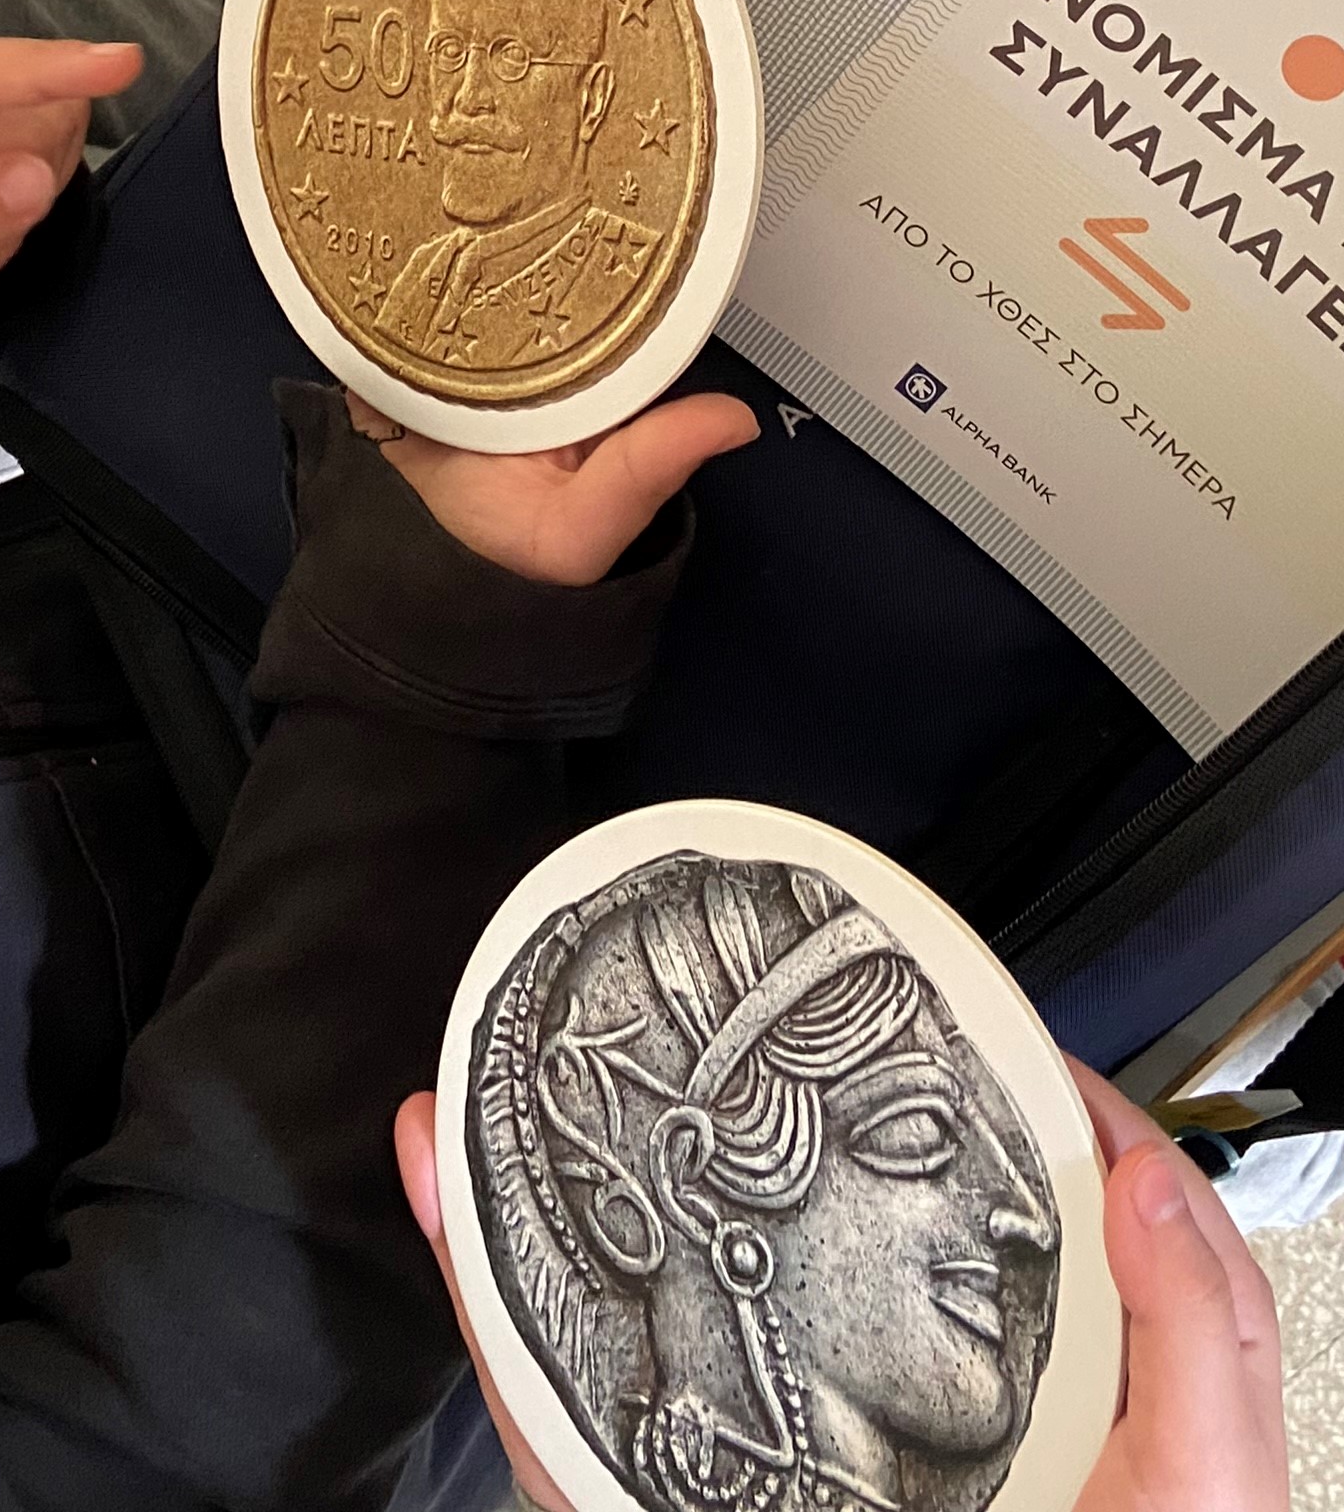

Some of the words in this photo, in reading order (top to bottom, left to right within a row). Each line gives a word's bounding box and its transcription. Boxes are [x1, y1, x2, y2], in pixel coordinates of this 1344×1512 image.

[317, 5, 415, 98] 50
[296, 107, 426, 166] ΛΕΠΤΑ
[326, 224, 395, 262] 2010
[859, 194, 929, 248] ΑΠΟ
[935, 243, 975, 284] ΤΟ
[976, 281, 1061, 355] ΧΘΕΣ
[1058, 348, 1120, 405] ΣΤΟ
[1120, 403, 1239, 521] ΣΗΜΕΡΑ
[941, 406, 1001, 458] ALPHA
[1001, 454, 1059, 505] BANK
